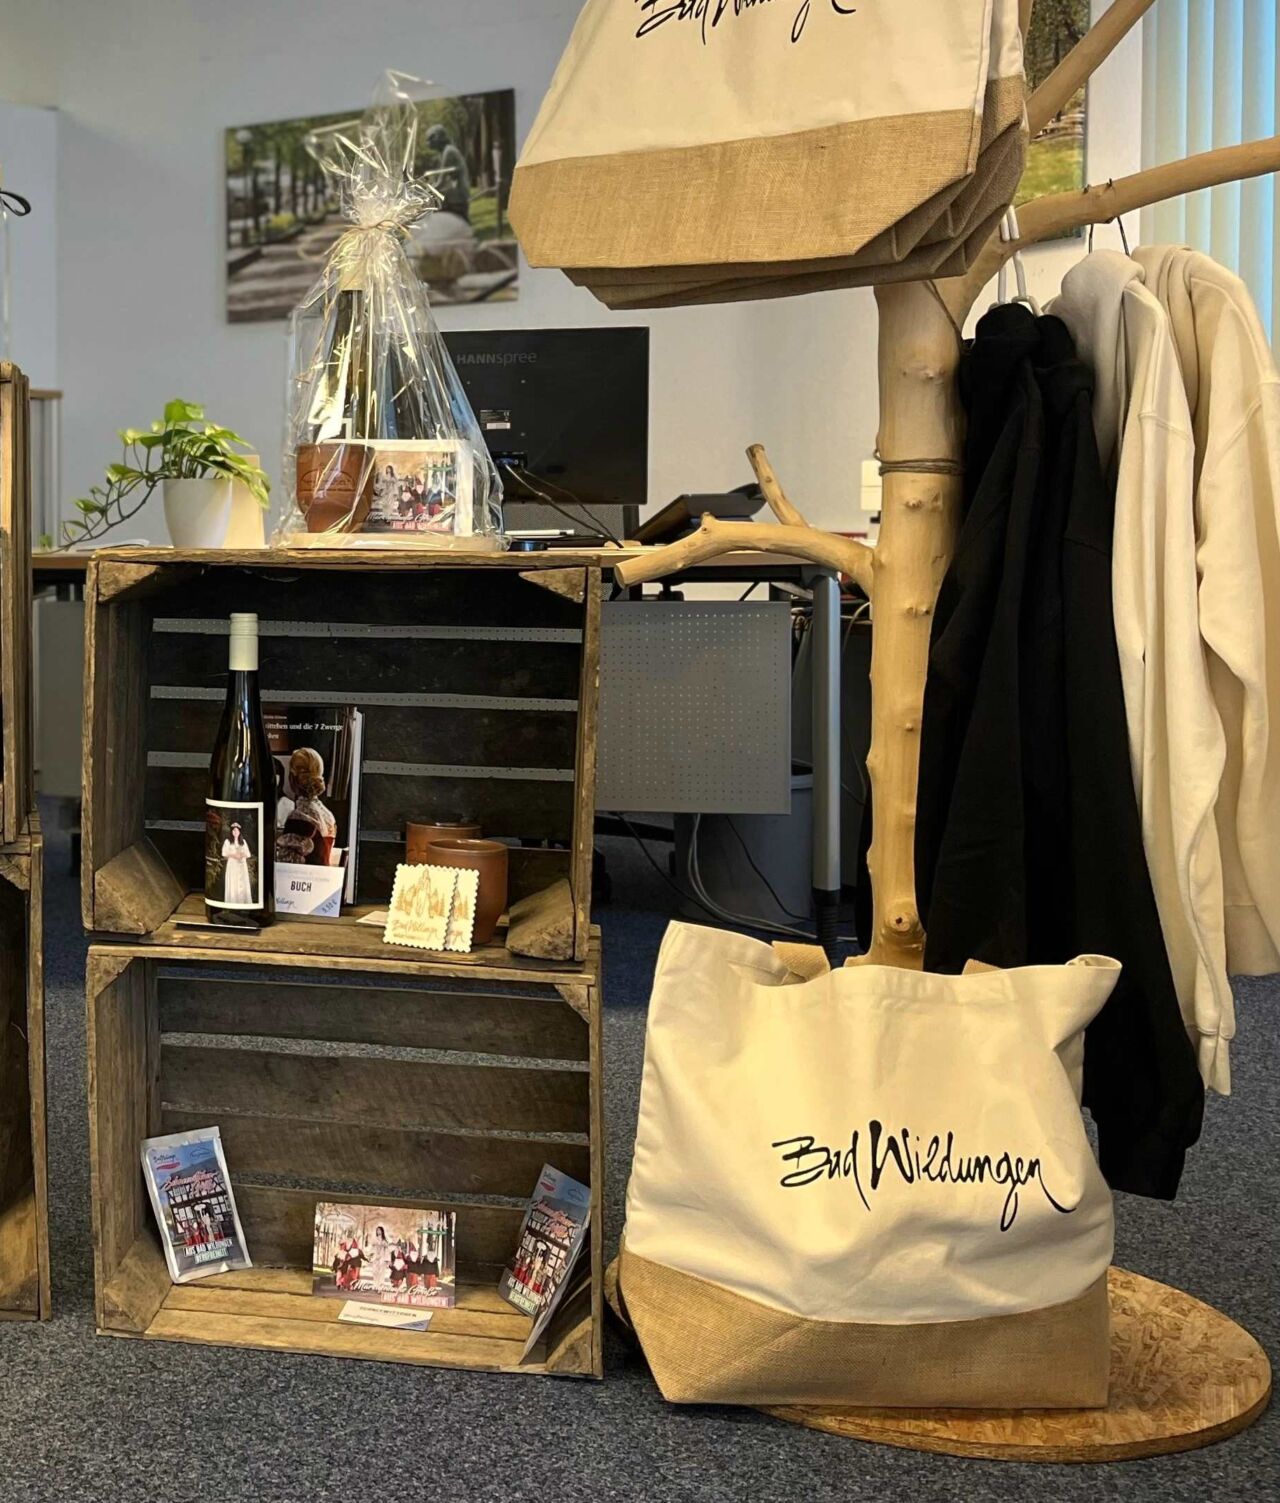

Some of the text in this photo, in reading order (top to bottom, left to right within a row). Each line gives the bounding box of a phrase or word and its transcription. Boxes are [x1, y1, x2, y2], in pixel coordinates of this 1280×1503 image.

[456, 352, 537, 367] HANNspree
[289, 722, 302, 730] und
[302, 722, 313, 730] die
[320, 723, 344, 732] Zwerge
[290, 880, 312, 892] BUCH
[772, 1119, 1077, 1232] Bad Wildungen
